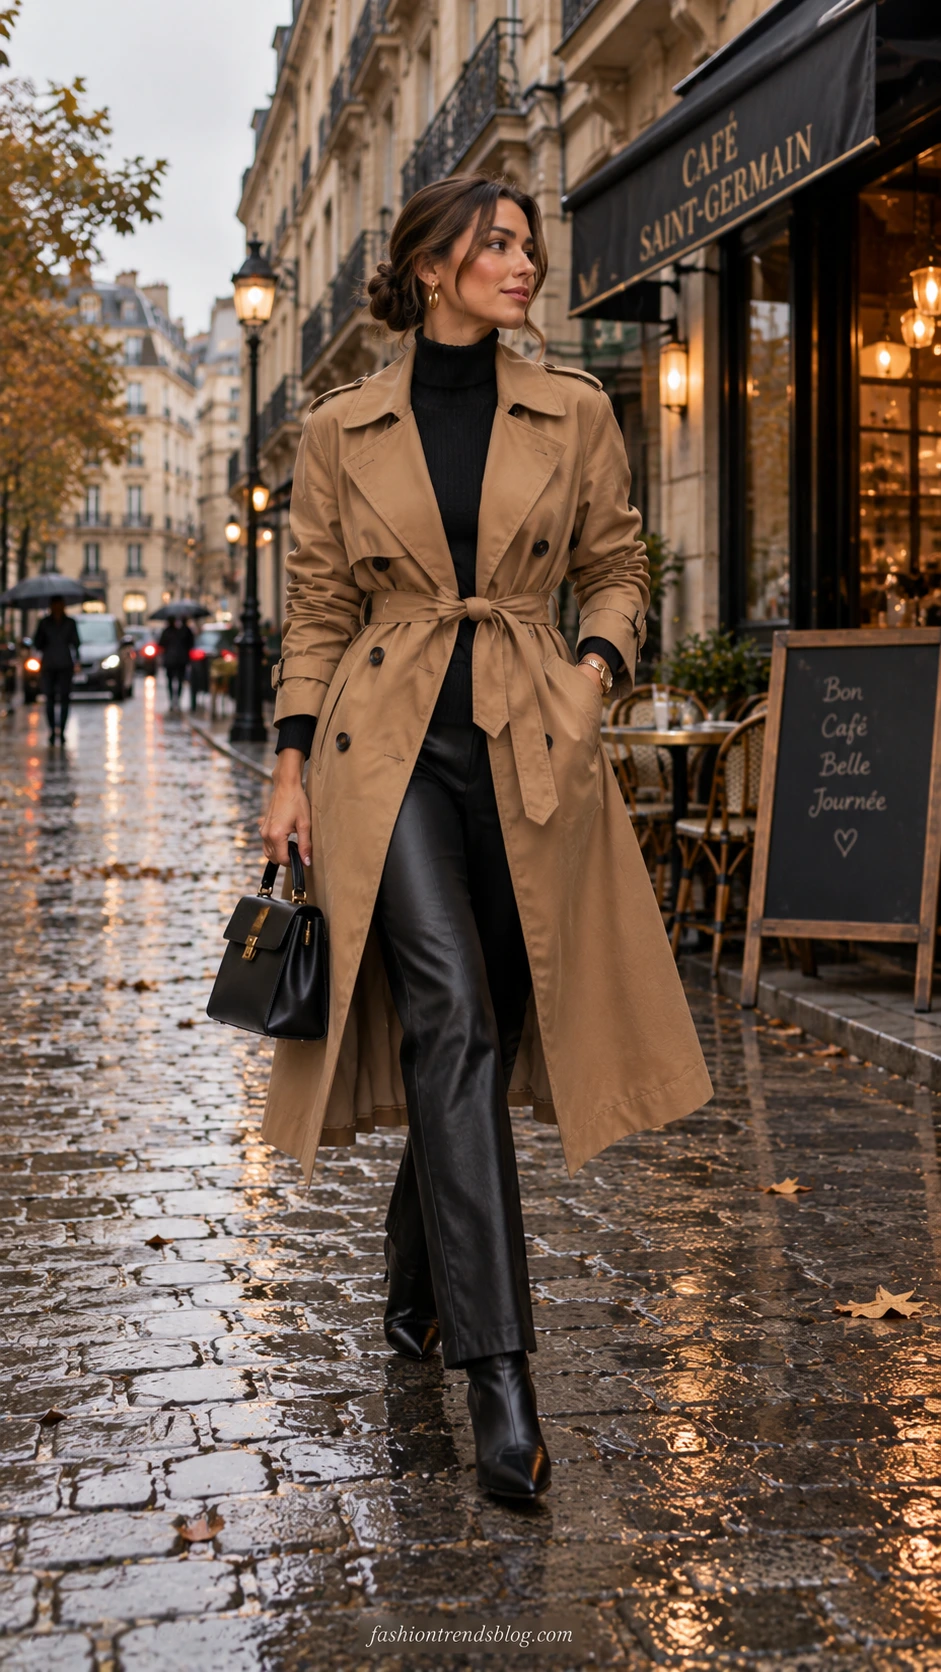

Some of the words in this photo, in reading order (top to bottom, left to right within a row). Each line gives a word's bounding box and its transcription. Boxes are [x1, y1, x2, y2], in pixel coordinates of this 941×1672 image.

[682, 110, 738, 188] CAFÉ
[639, 123, 813, 262] SAINT-GERMAIN
[822, 676, 864, 703] Bon
[821, 713, 868, 745] Café
[819, 751, 871, 777] Belle
[808, 787, 888, 818] Journée
